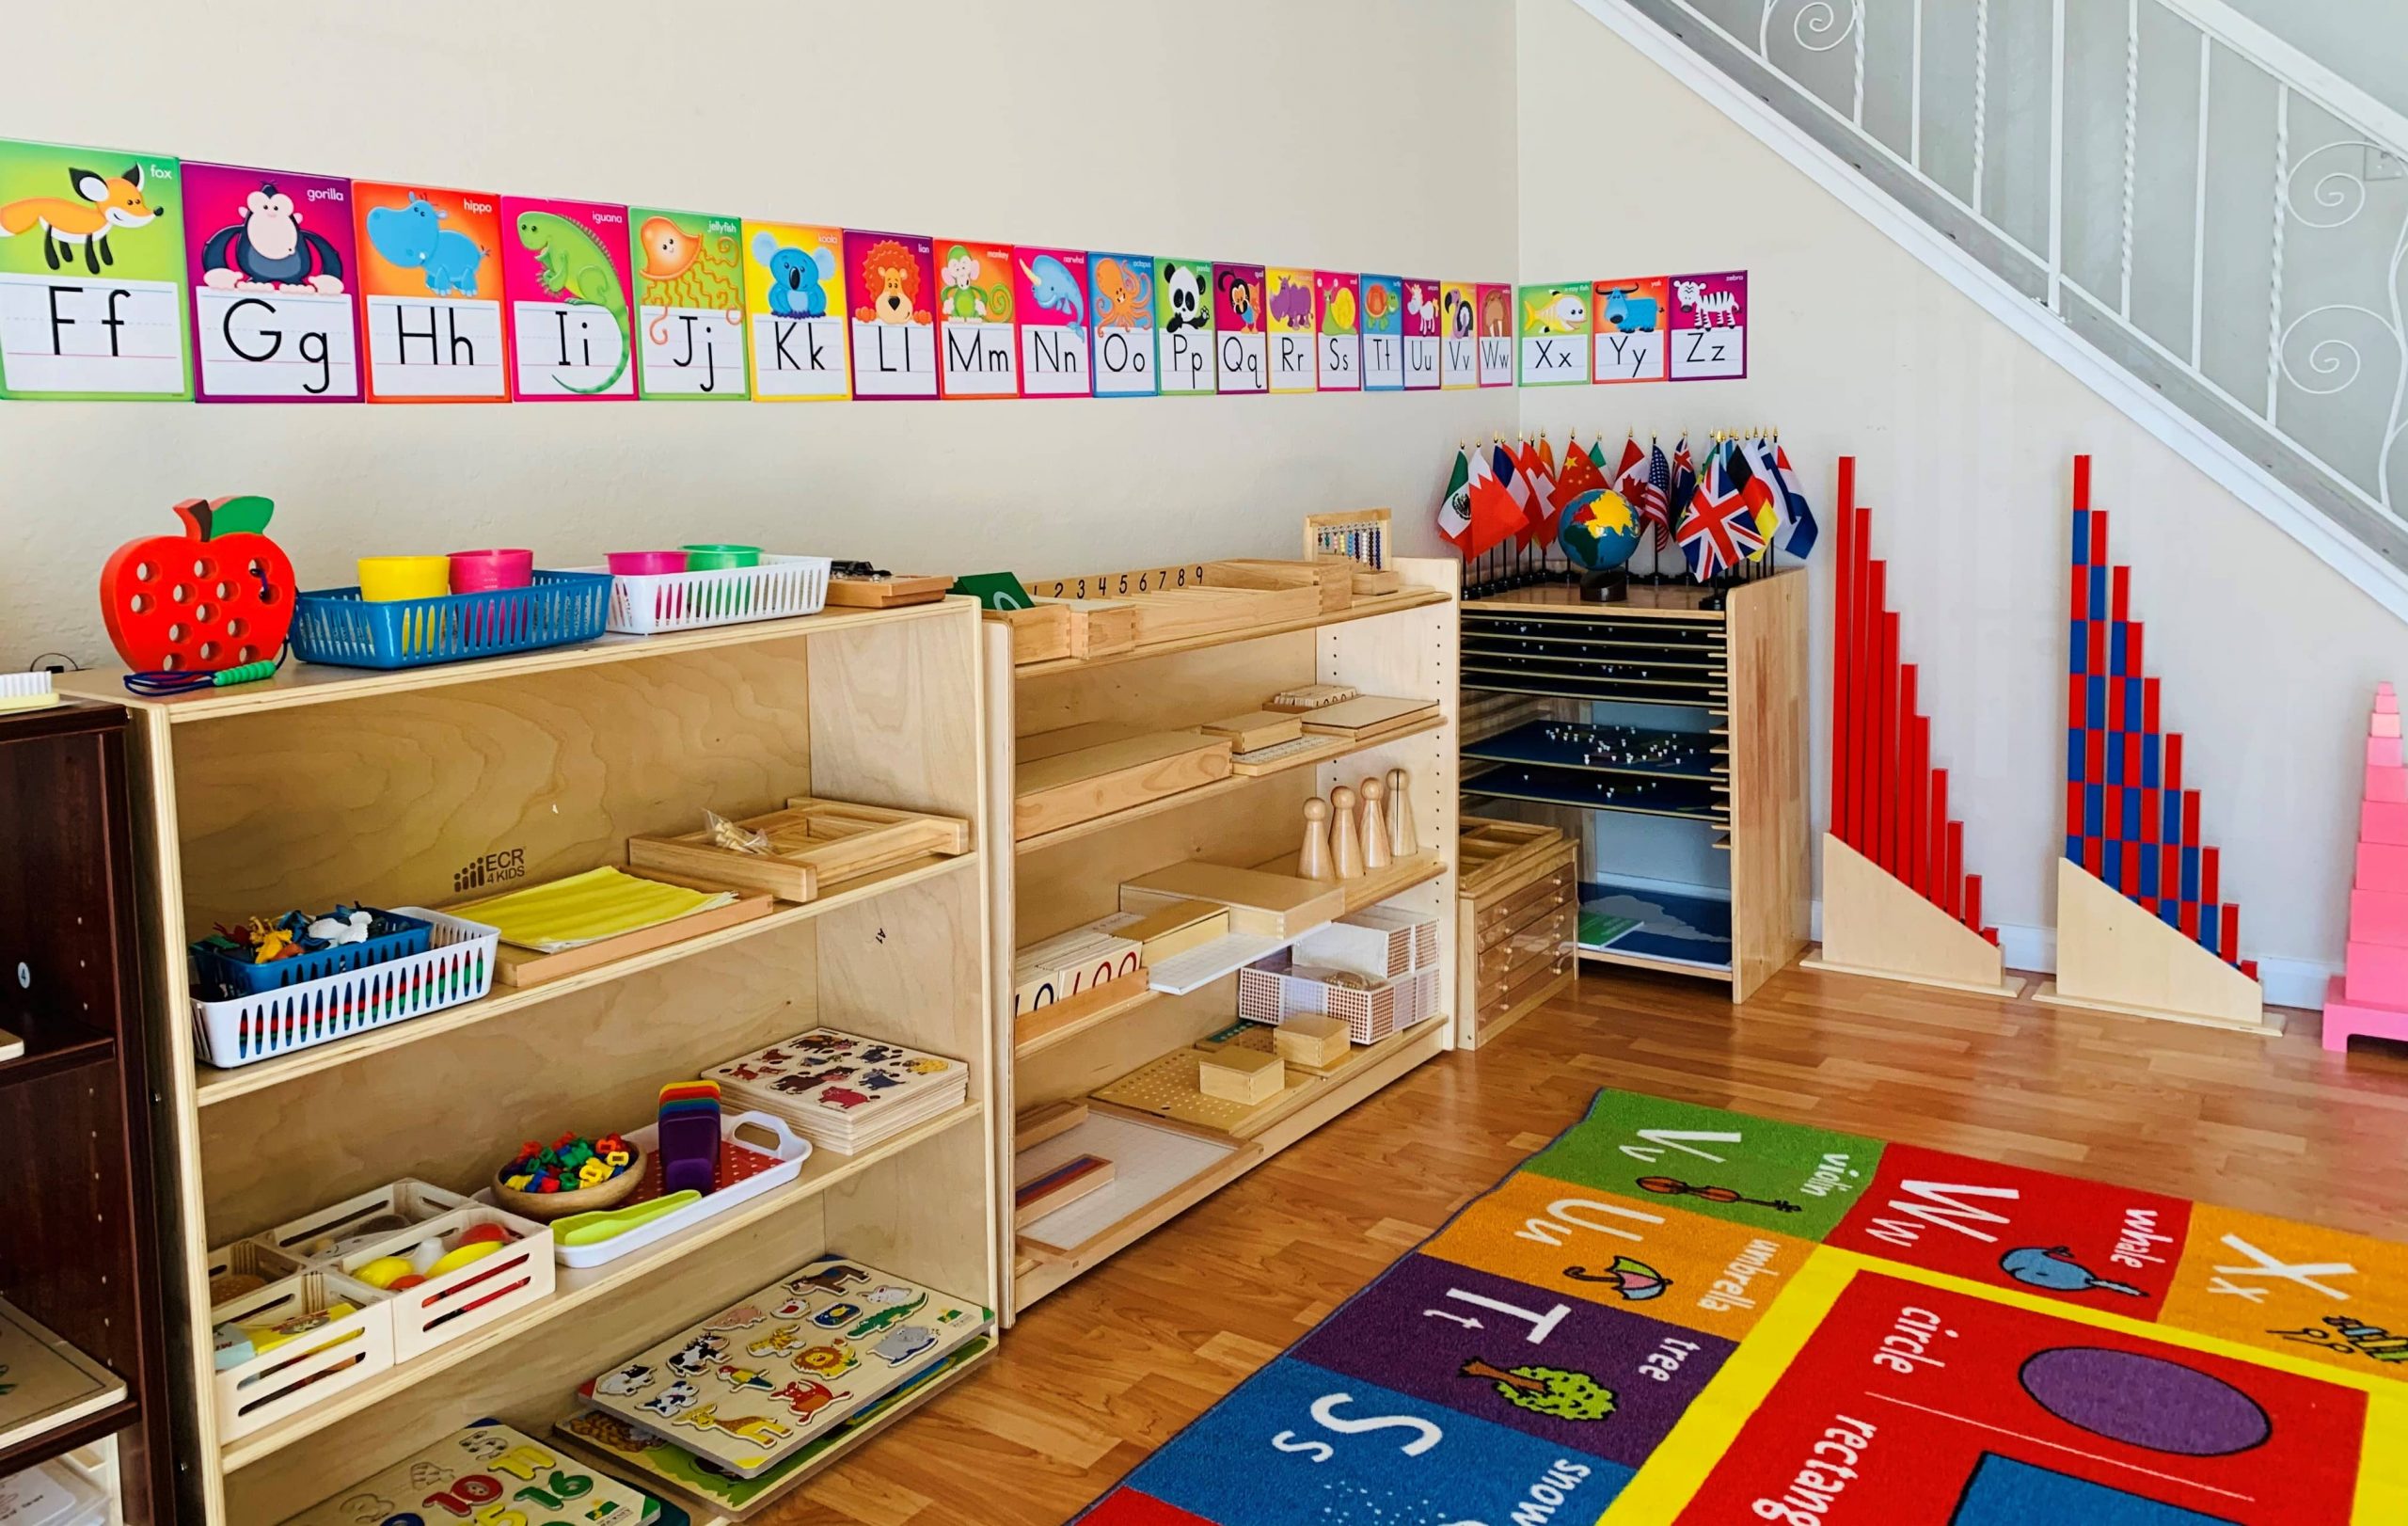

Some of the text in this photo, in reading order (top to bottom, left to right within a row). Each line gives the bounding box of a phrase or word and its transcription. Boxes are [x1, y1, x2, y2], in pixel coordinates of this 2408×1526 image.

[150, 164, 173, 180] fox
[307, 188, 344, 201] gorilla
[464, 198, 493, 215] hippo
[592, 210, 623, 225] iguana
[707, 220, 737, 235] jellyfish
[1725, 274, 1744, 283] zebra
[48, 285, 132, 358] Ff
[396, 304, 475, 366] Hh
[223, 297, 330, 394] Gg
[673, 315, 715, 392] Jj
[774, 320, 826, 371] Kk
[947, 327, 1009, 373] Mm
[1034, 330, 1077, 373] Nn
[1103, 332, 1146, 373] Oo
[1173, 333, 1203, 389] Pp
[1223, 336, 1262, 389] Qq
[1280, 336, 1305, 373] Rr
[1329, 337, 1349, 372] Ss
[1372, 338, 1390, 371] Tt
[1410, 340, 1433, 372] Uu
[1449, 341, 1470, 371] Vv
[1481, 340, 1510, 370] Ww
[1534, 339, 1573, 369] Xx
[1608, 335, 1647, 378] Yy
[1686, 332, 1726, 362] Zz
[1054, 581, 1064, 597] 2
[1076, 579, 1085, 599] 3
[1099, 577, 1106, 596] 4
[1118, 574, 1128, 595] 5
[1139, 572, 1148, 592] 6
[1159, 570, 1166, 589] 7
[1177, 568, 1185, 587] 8
[1196, 565, 1203, 584] 9
[485, 848, 525, 872] ECR
[486, 865, 526, 883] 4 KIDS
[1799, 1152, 1861, 1198] violin
[2110, 1207, 2174, 1270] whale
[1696, 1237, 1782, 1313] umbrella
[1637, 1336, 1702, 1382] tree
[1872, 1305, 1960, 1375] circle
[421, 1473, 504, 1518] 10
[513, 1470, 594, 1511] 16
[1510, 1458, 1592, 1526] snow
